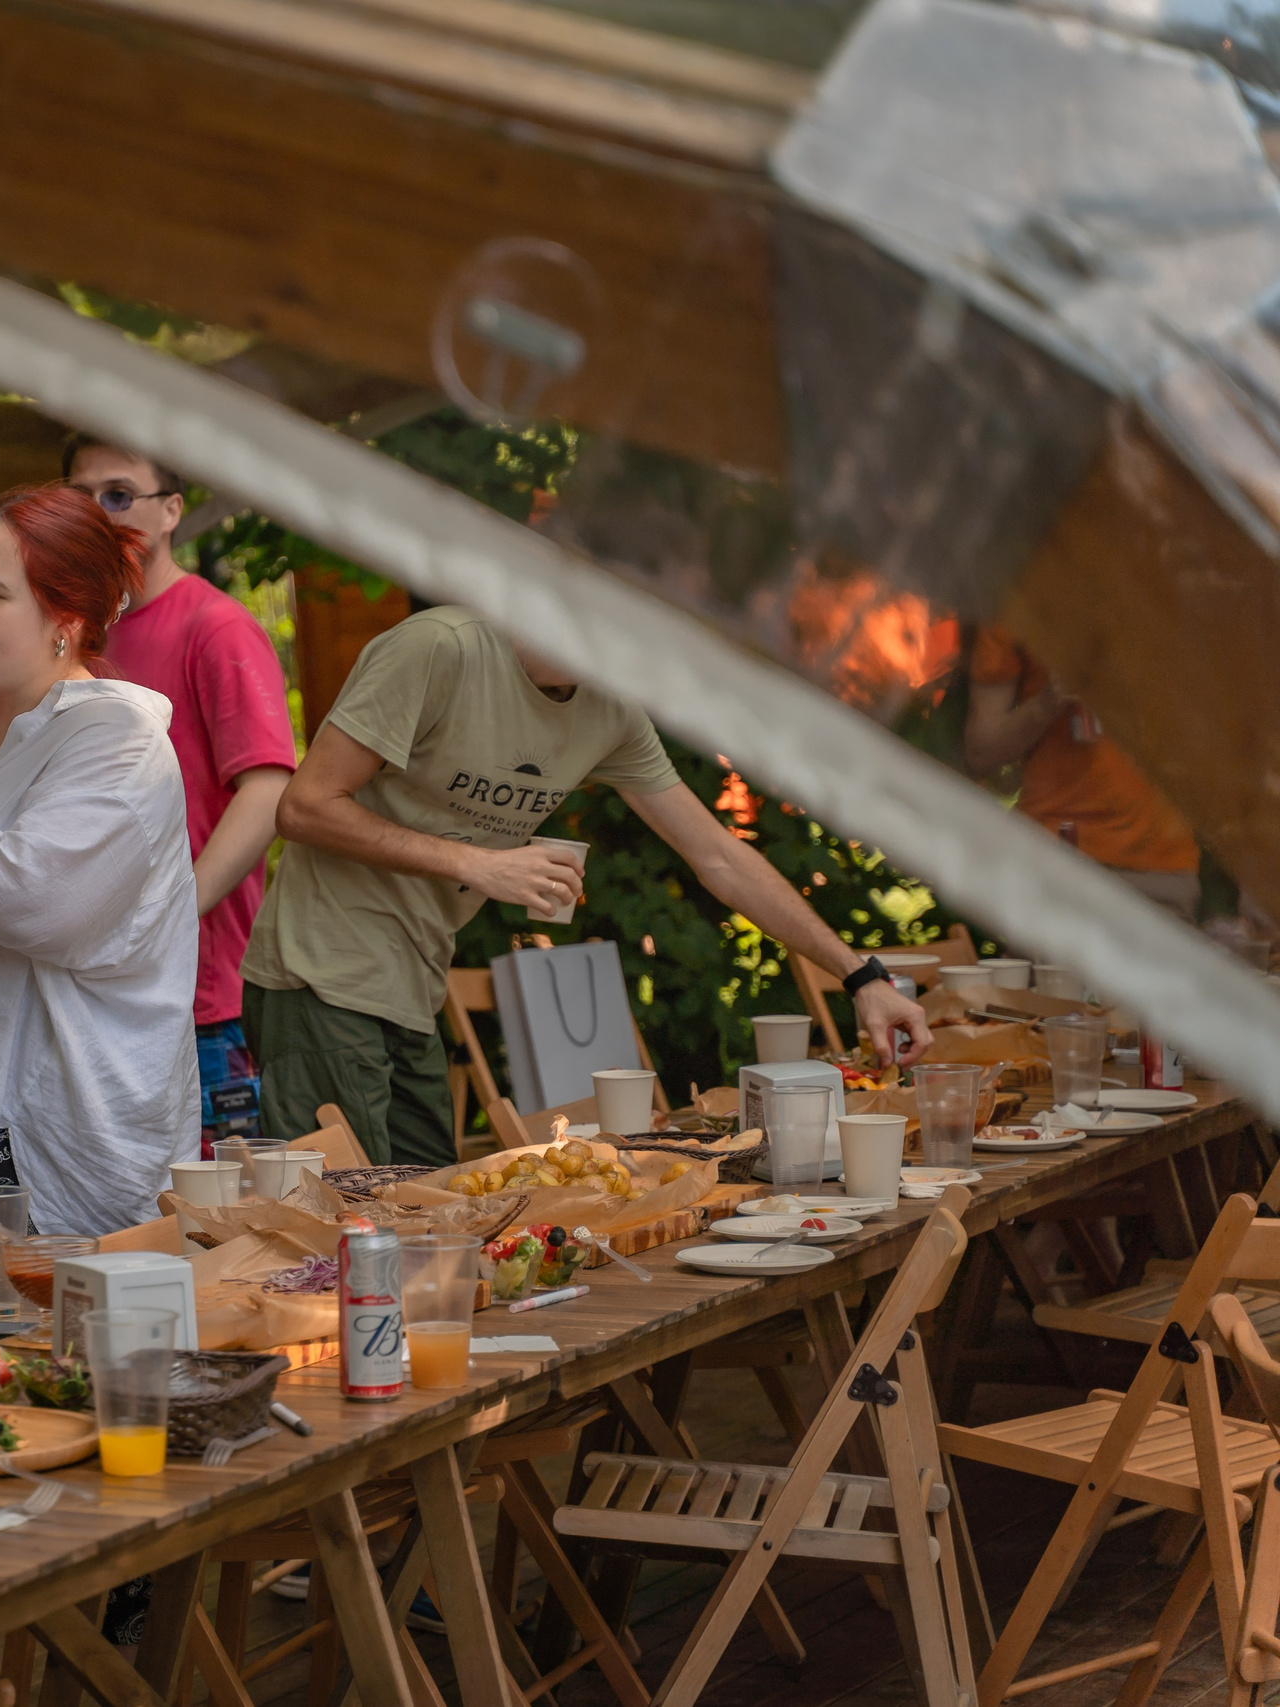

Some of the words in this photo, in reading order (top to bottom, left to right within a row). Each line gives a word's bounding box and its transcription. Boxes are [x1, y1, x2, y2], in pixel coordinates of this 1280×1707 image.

[447, 769, 570, 813] PROTES
[448, 801, 480, 818] SURF
[481, 813, 505, 826] AND
